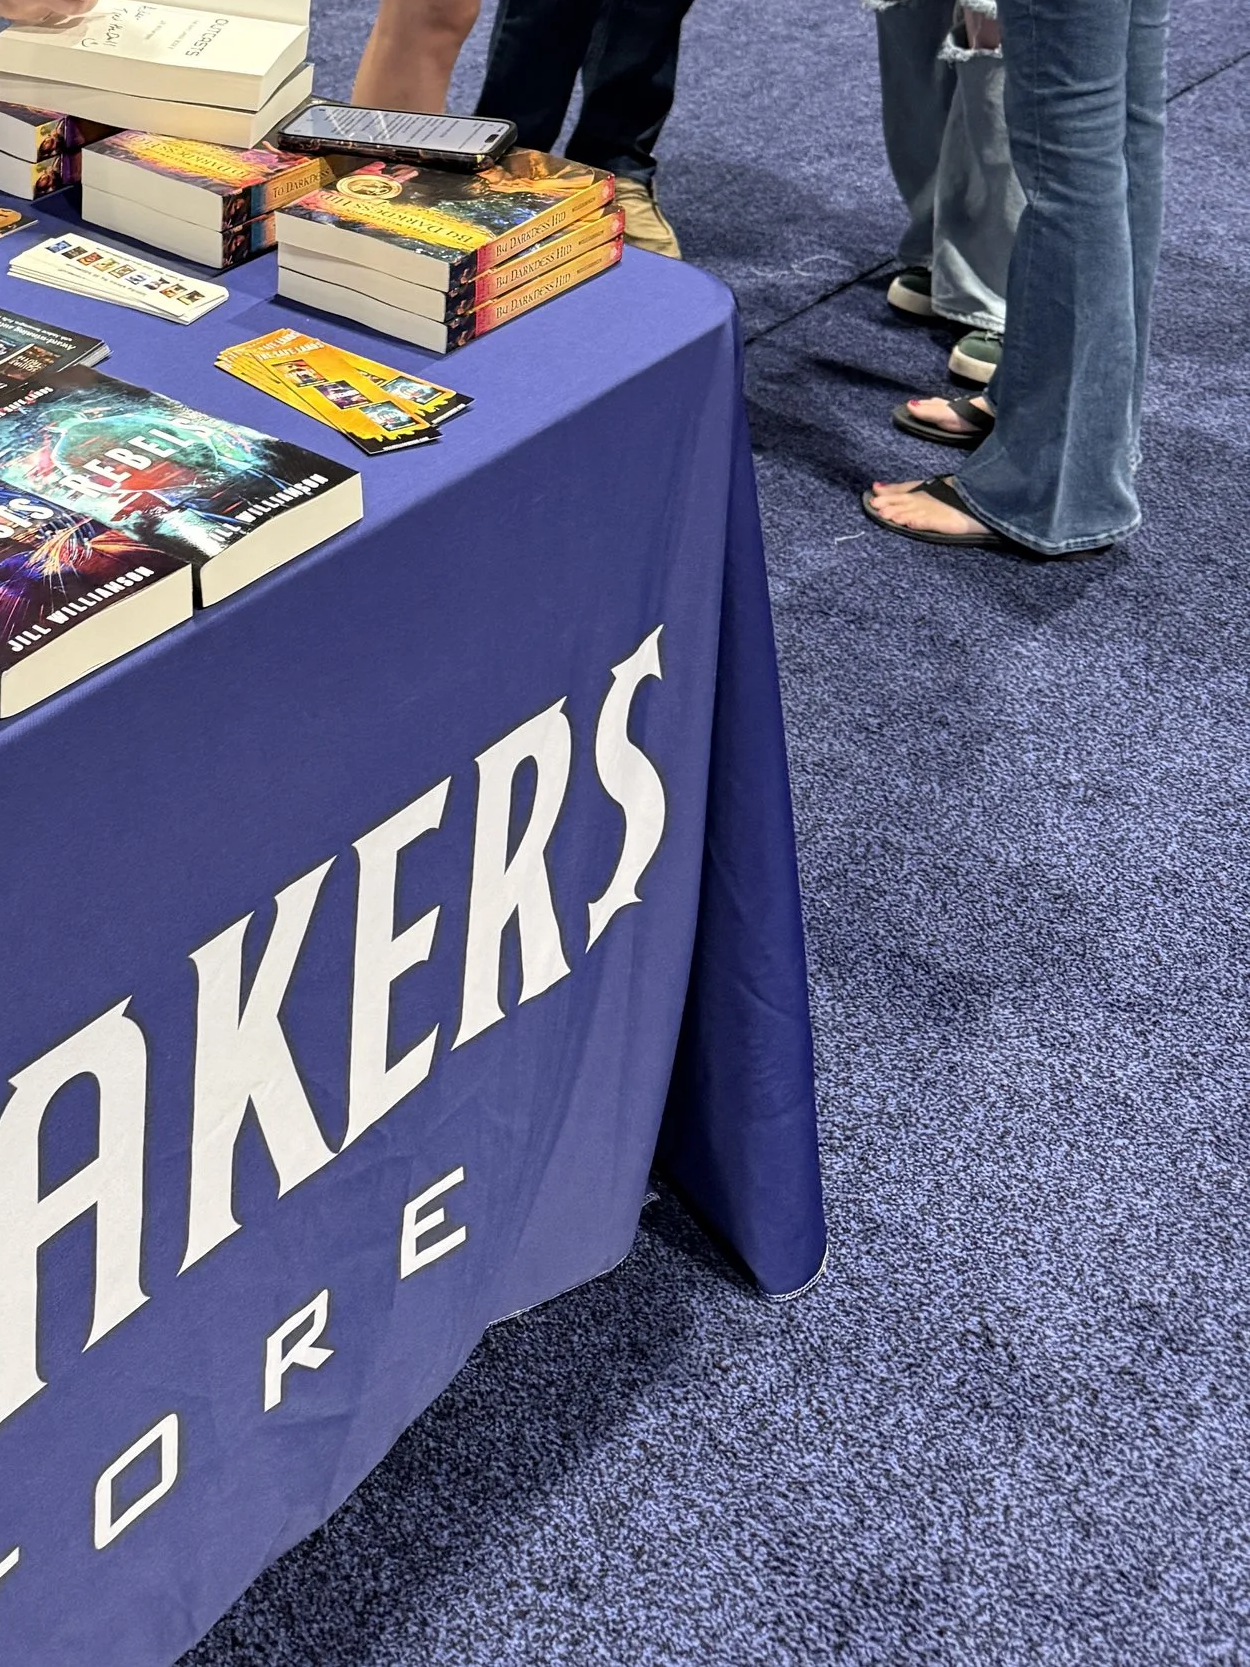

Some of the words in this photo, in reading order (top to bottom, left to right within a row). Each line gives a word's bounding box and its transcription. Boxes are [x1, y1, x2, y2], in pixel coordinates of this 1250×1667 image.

[185, 18, 230, 57] OUTCASTS
[59, 413, 214, 501] REBELS
[238, 472, 330, 525] WILLIAMSON
[6, 623, 52, 654] JILL
[47, 564, 155, 625] WILLIAMSON
